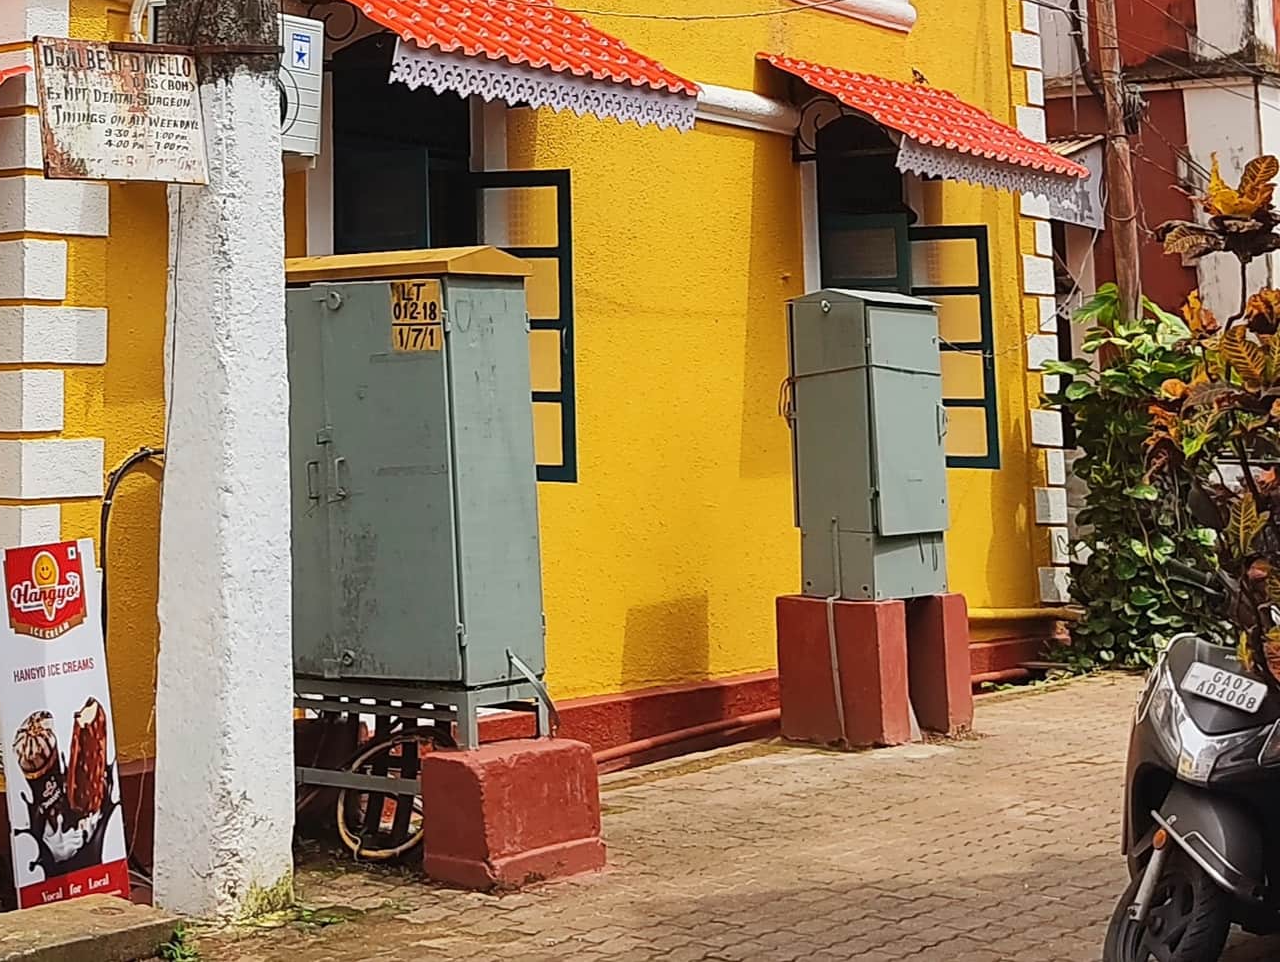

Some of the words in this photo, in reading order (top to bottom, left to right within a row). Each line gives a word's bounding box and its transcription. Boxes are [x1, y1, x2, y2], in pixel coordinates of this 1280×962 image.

[94, 88, 133, 105] DENTAL
[137, 92, 191, 108] SURGEON
[51, 104, 107, 126] TIMINGS
[148, 116, 200, 130] WEEKDAYS
[401, 283, 426, 301] LT
[393, 301, 437, 320] 012-18
[398, 326, 434, 350] 1/7/1
[12, 583, 76, 608] Hangyo
[30, 626, 44, 637] ICE
[45, 621, 70, 638] CREAM
[13, 665, 46, 682] HANGYO
[47, 663, 61, 676] ICE
[62, 657, 95, 674] CREAMS
[1213, 671, 1254, 693] GA07
[1195, 681, 1257, 710] AD4008
[41, 887, 63, 902] Vocal
[69, 883, 83, 895] for
[88, 873, 110, 890] Local
